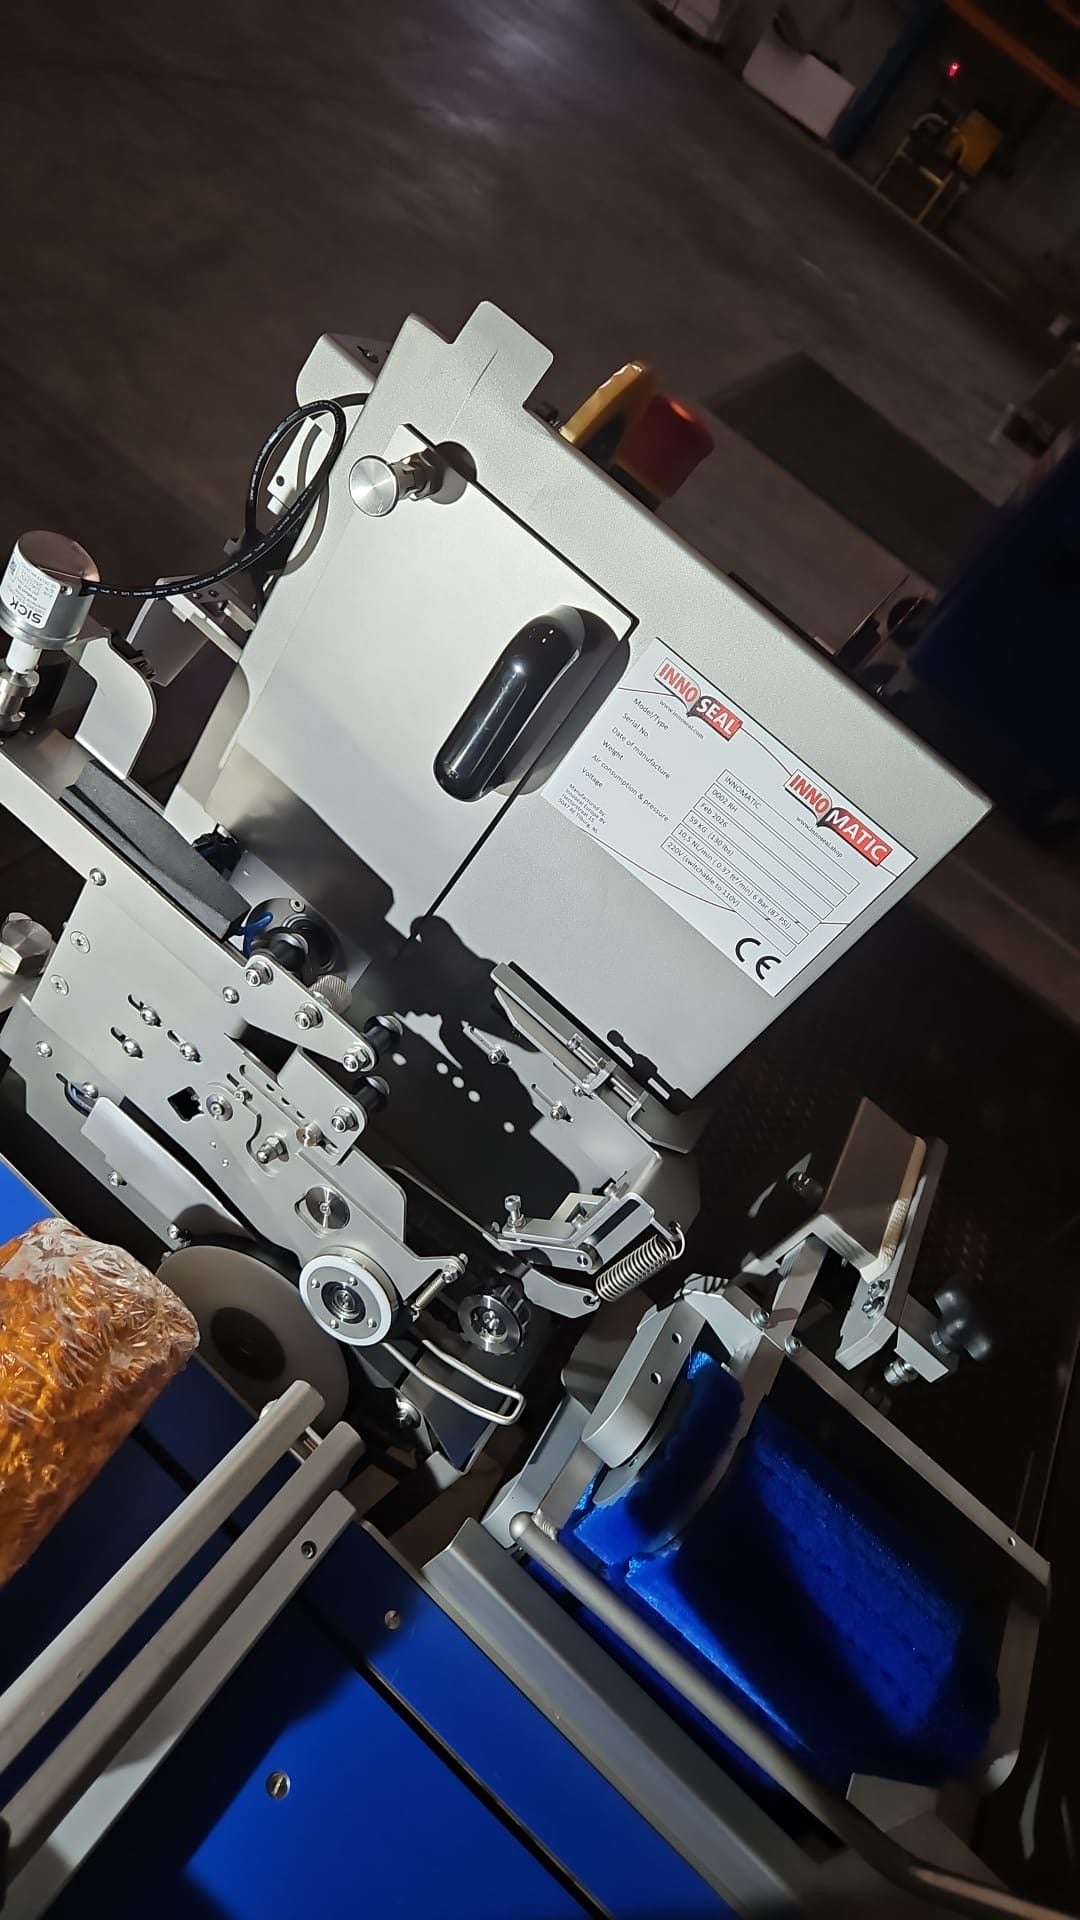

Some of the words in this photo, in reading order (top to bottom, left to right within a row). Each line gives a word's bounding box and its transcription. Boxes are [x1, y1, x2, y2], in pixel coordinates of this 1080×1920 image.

[10, 596, 43, 624] SICK
[622, 712, 641, 730] Serial
[638, 726, 652, 739] No.
[632, 698, 670, 732] Model/Type
[601, 740, 625, 762] Weight
[611, 726, 628, 743] Date
[626, 739, 635, 749] of
[632, 744, 672, 780] manufacture
[581, 767, 605, 789] Voltage
[591, 753, 603, 765] Air
[599, 761, 639, 797] consumption
[636, 792, 645, 801] &
[642, 798, 670, 824] pressure
[723, 775, 763, 810] INNOMATIC
[699, 802, 714, 816] Feb
[711, 812, 729, 829] 2026
[711, 788, 729, 805] 0002
[726, 802, 738, 813] RH
[688, 815, 699, 826] 59
[696, 822, 708, 834] KG
[707, 831, 724, 848] (130
[720, 843, 735, 857] lbs)
[666, 841, 685, 858] 220V
[681, 854, 717, 886] (switchable
[714, 882, 724, 892] to
[721, 889, 741, 908] 110V)
[751, 893, 760, 901] 6
[756, 897, 770, 910] Bar
[776, 916, 793, 930] PSI)
